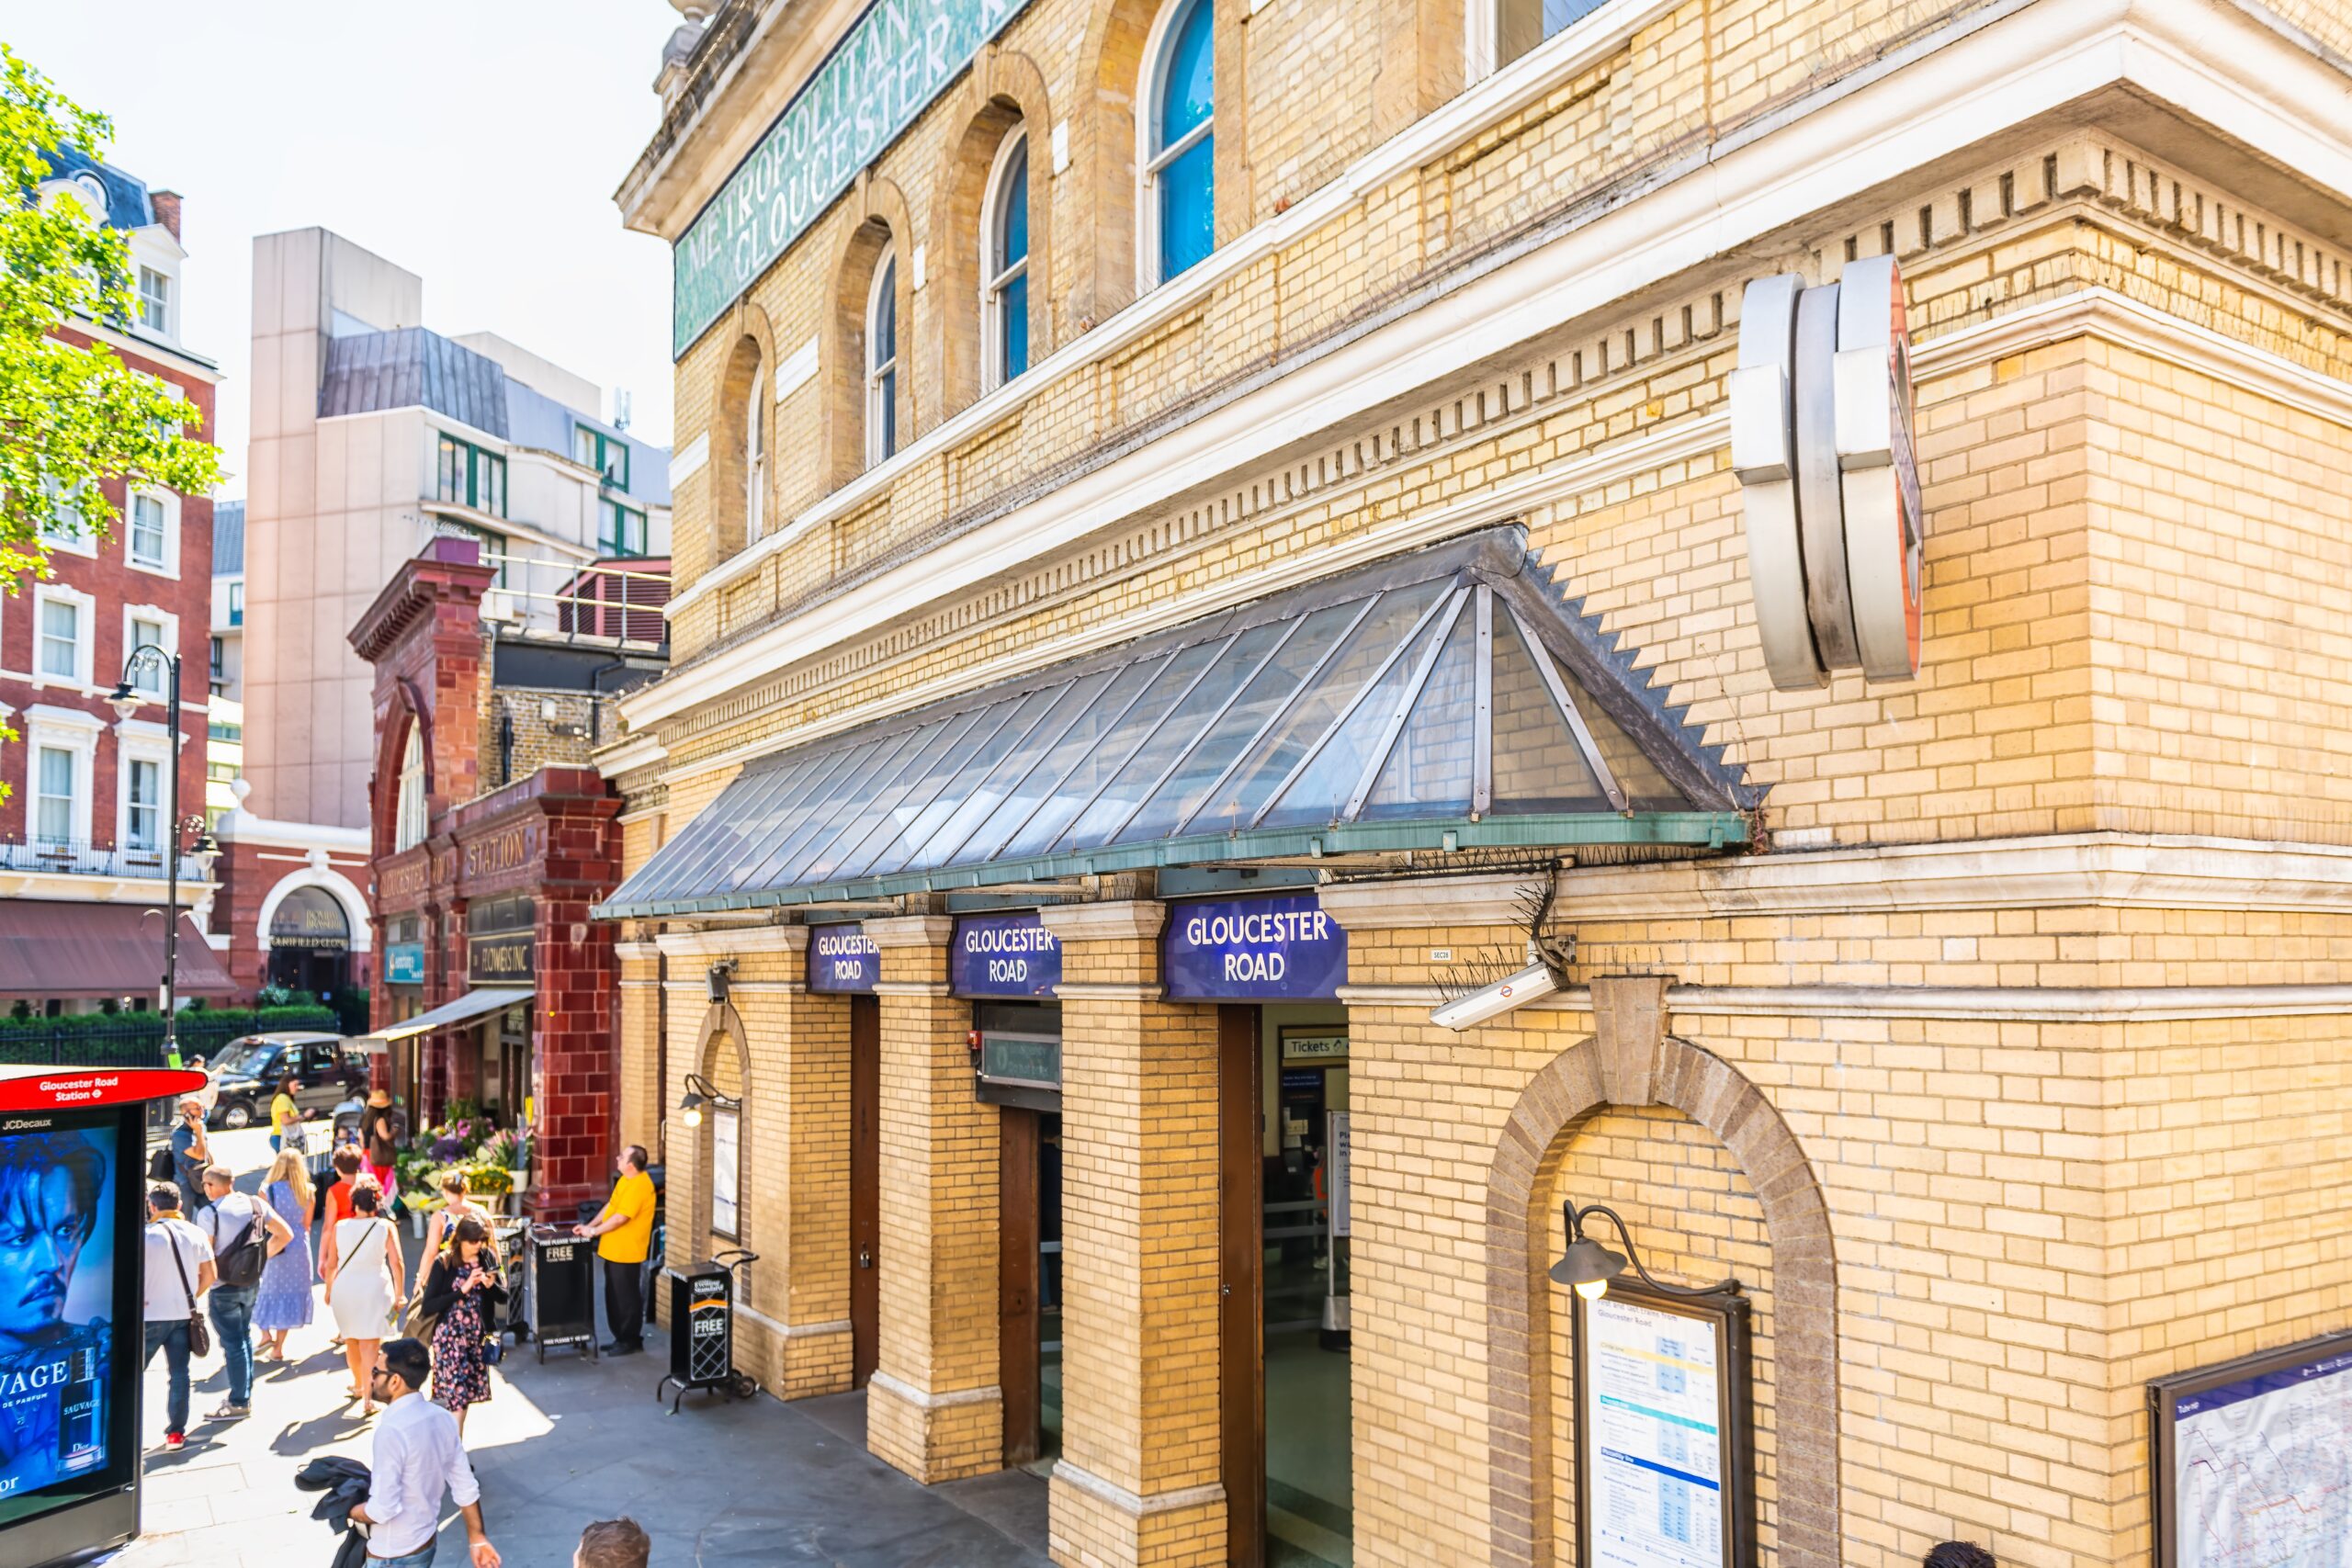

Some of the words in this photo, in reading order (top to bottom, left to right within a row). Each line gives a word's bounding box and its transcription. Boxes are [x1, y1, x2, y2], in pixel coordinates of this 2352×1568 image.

[688, 0, 910, 283] METROPOLITAN
[735, 13, 950, 283] GLOUCESTER
[469, 828, 525, 876] STATION
[1187, 910, 1329, 945] GLOUCESTER
[966, 928, 1055, 953] GLOUCESTER
[481, 946, 513, 973] FLOWERS
[513, 945, 528, 972] INC
[1225, 953, 1285, 981] ROAD
[835, 961, 862, 980] ROAD
[989, 959, 1028, 983] ROAD
[1292, 1041, 1330, 1053] Tickets
[40, 1079, 93, 1091] Gloucester
[95, 1077, 119, 1088] Road
[55, 1091, 90, 1101] Station
[2, 1119, 52, 1131] JCDecaux
[546, 1245, 574, 1258] FREE
[694, 1318, 723, 1333] FREE
[3, 1401, 13, 1409] DE
[16, 1393, 48, 1405] PARFUM
[63, 1399, 101, 1416] SAUVAGE
[73, 1443, 89, 1453] Dior
